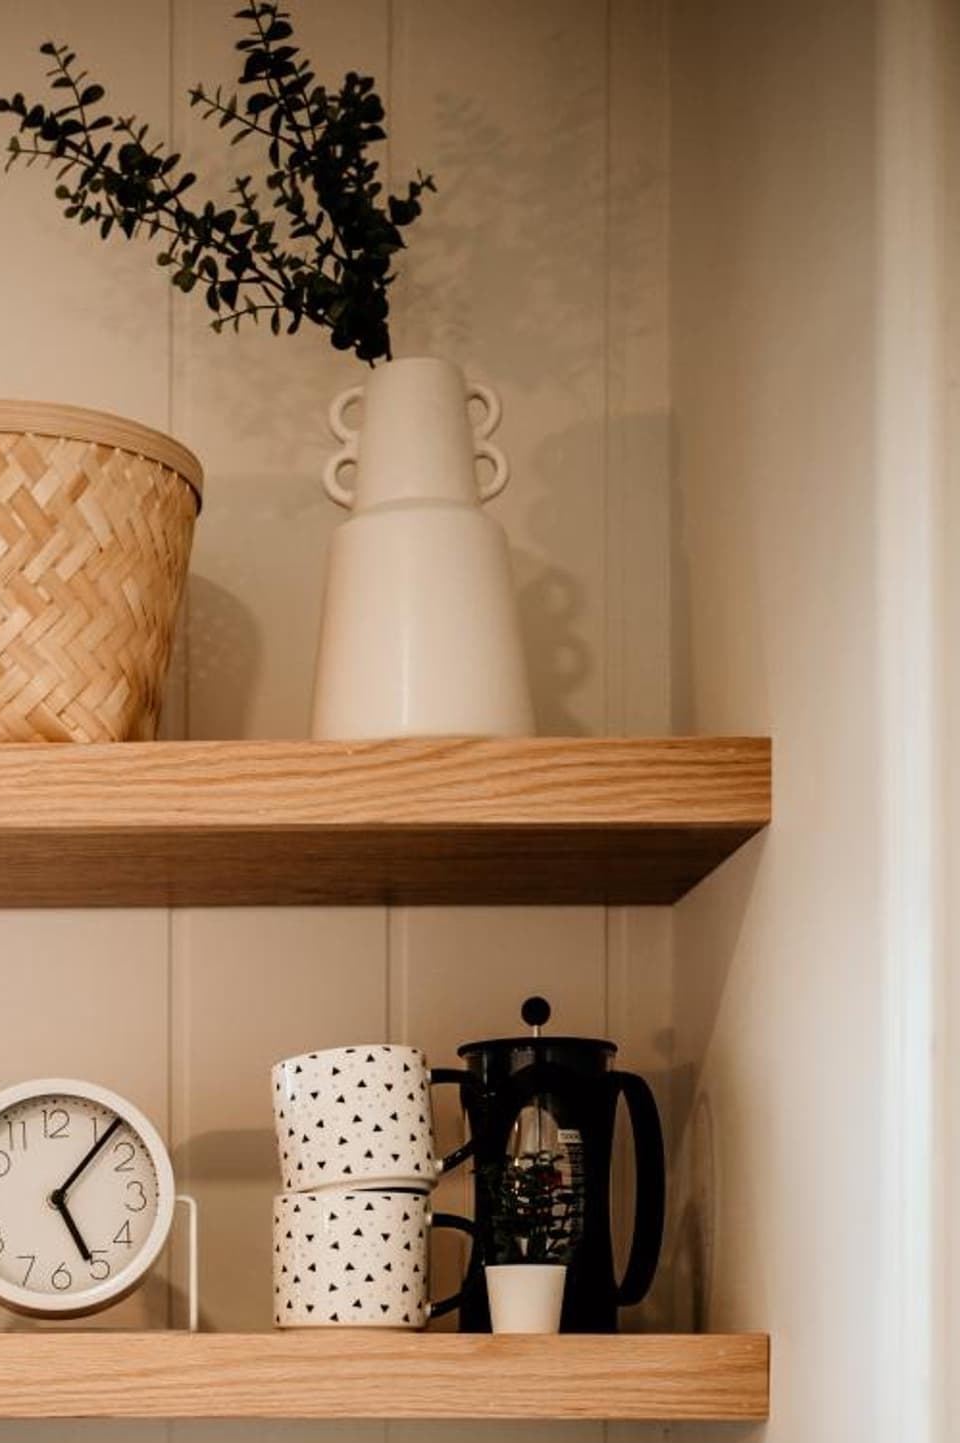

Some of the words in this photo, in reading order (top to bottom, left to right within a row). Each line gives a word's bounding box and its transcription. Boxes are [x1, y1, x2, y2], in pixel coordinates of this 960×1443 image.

[7, 1121, 27, 1150] 11
[41, 1109, 70, 1139] 12
[112, 1141, 136, 1172] 2
[124, 1180, 147, 1212] 3
[112, 1219, 133, 1249] 4
[16, 1255, 36, 1287] 7
[51, 1261, 72, 1290] 6
[88, 1250, 111, 1280] 5
